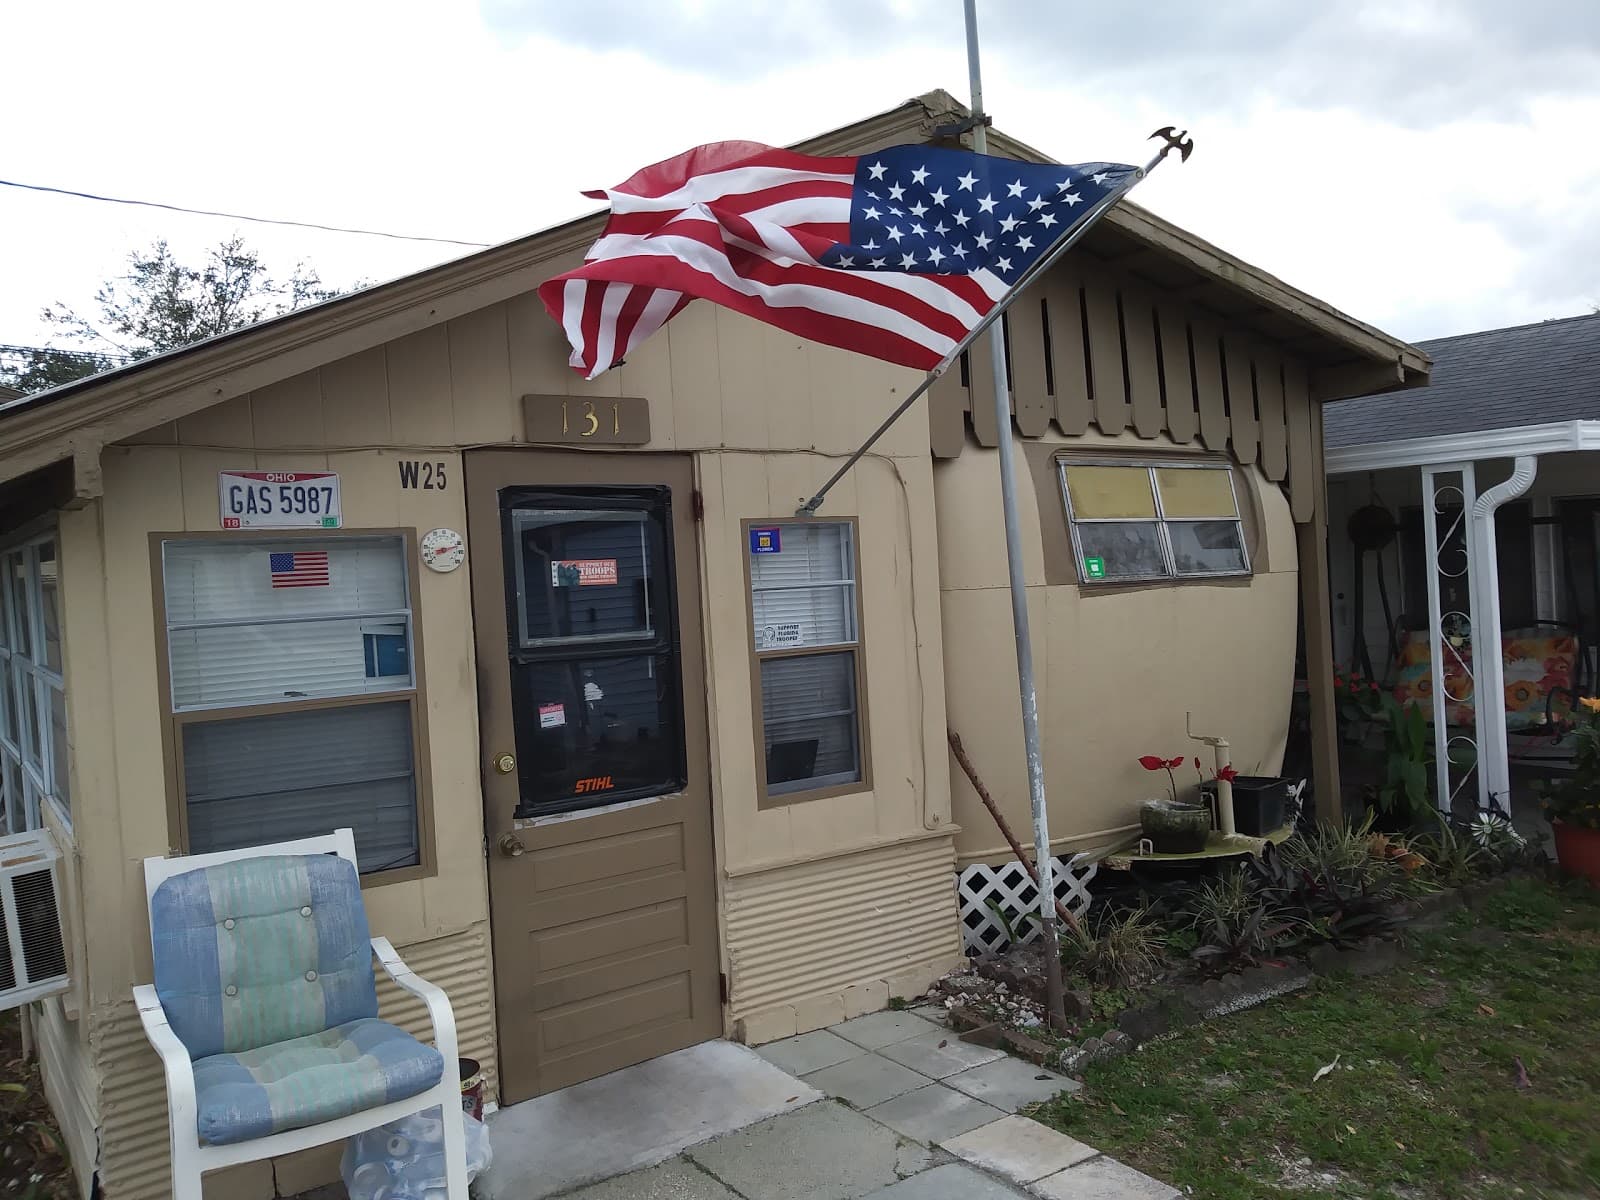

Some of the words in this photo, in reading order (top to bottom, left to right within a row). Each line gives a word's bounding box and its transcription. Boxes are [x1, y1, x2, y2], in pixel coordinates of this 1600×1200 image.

[561, 401, 620, 437] 131
[266, 473, 296, 482] OHIO
[398, 460, 448, 490] W25
[230, 485, 273, 515] GAS
[279, 486, 333, 515] 5987
[226, 519, 239, 528] 18
[578, 566, 616, 576] TROOPS
[575, 776, 615, 793] STIHL
